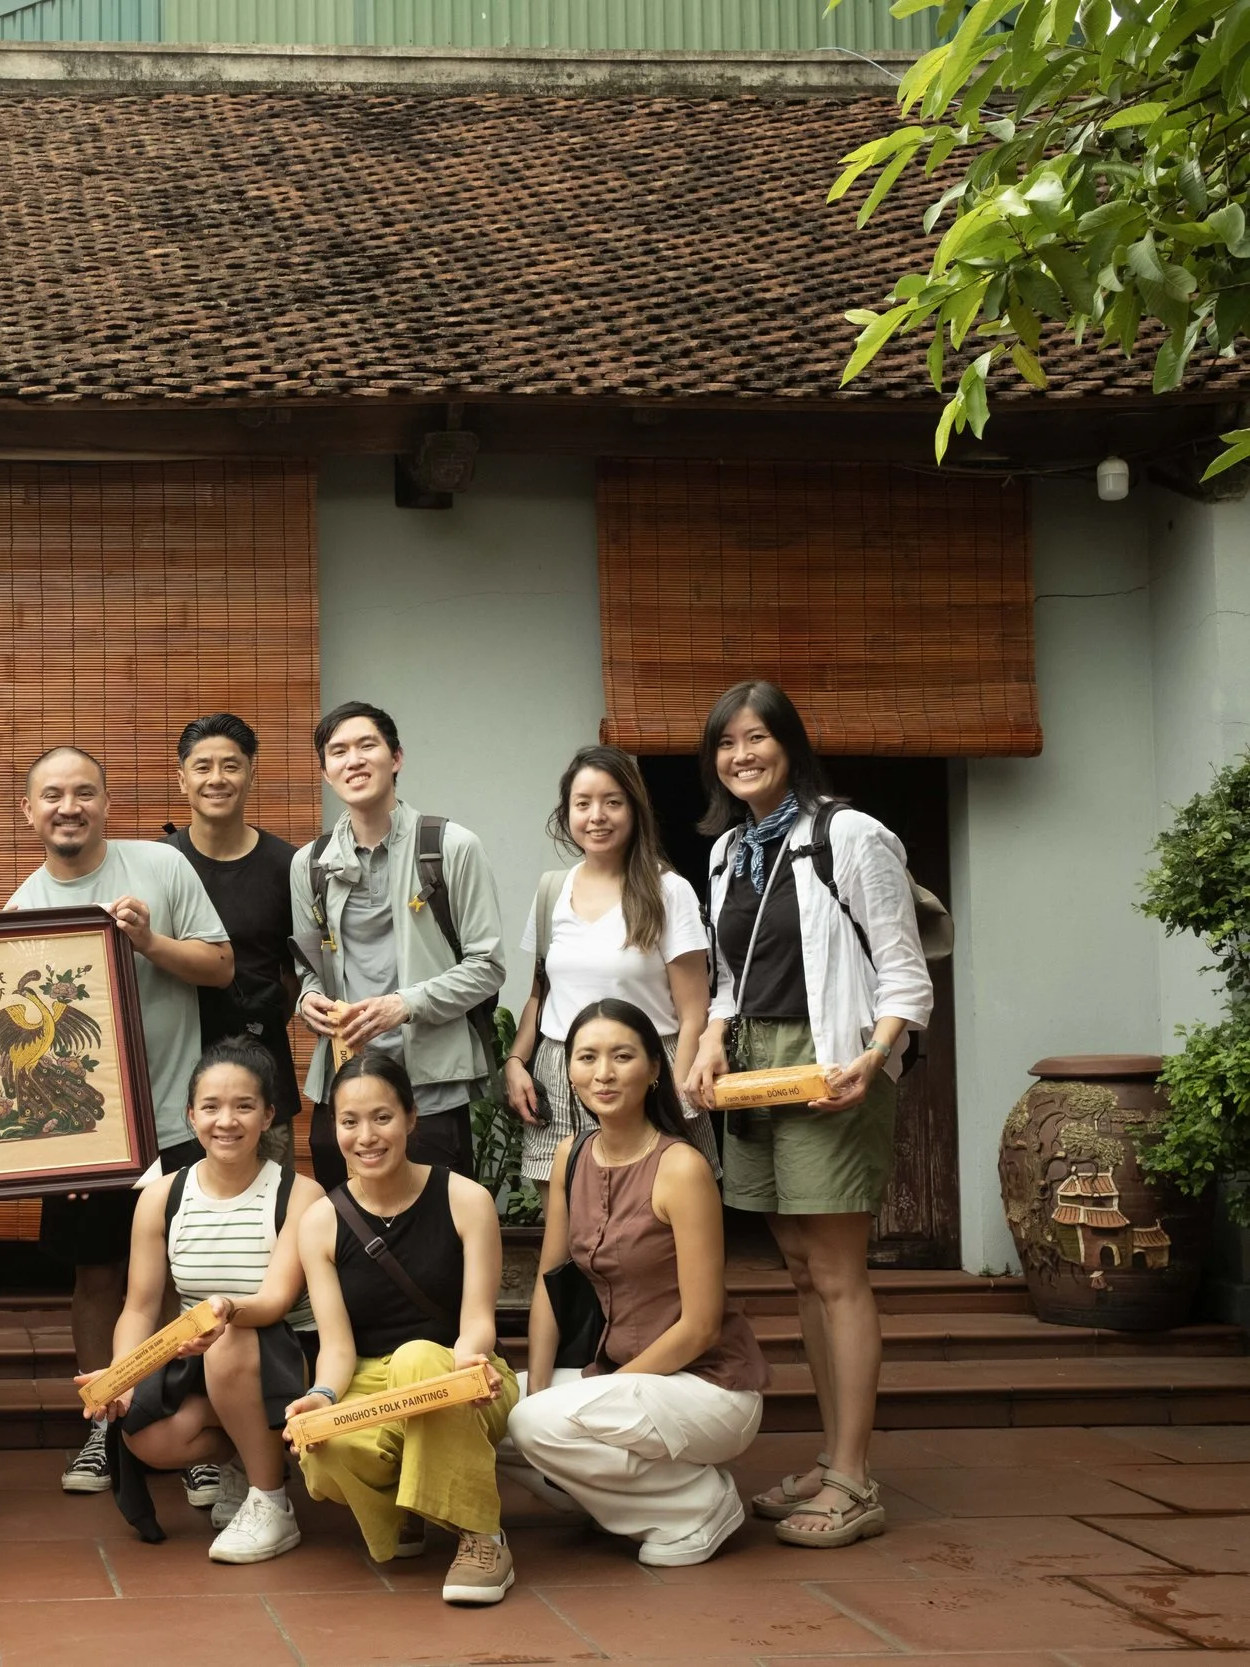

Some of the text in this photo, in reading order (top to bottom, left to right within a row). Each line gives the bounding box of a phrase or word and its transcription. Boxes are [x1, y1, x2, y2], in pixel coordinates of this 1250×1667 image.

[334, 1388, 449, 1426] DONGHO'S FOLK PAINTINGS
